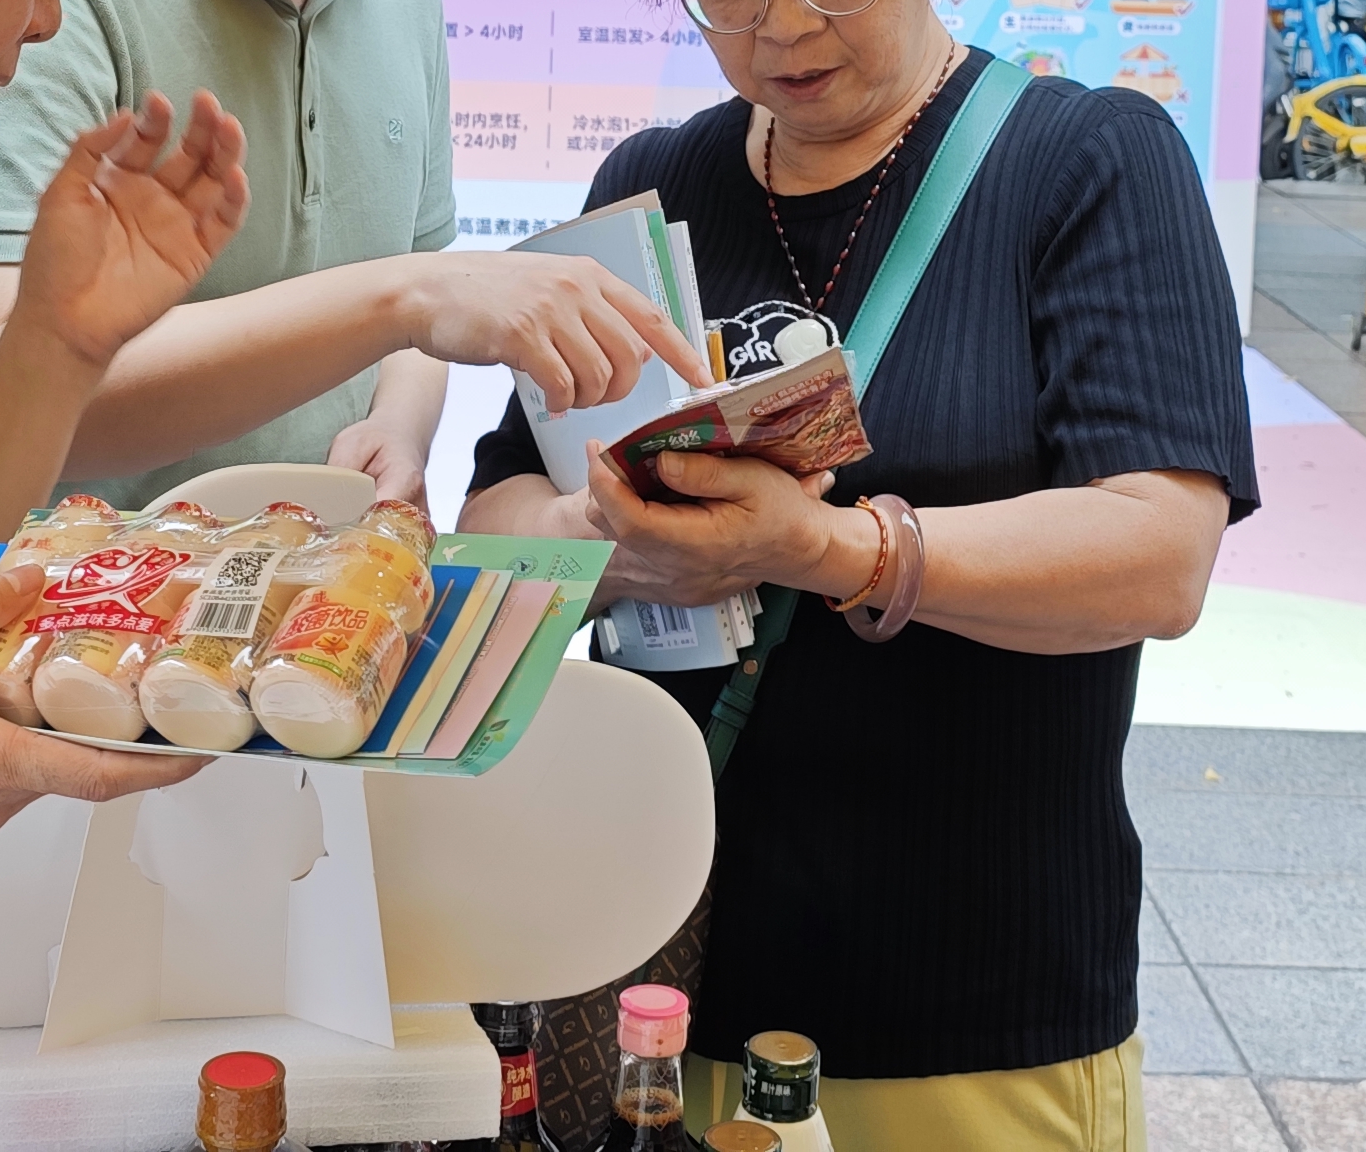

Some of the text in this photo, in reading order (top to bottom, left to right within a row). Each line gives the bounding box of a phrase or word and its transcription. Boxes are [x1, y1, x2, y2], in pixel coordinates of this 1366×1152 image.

[38, 612, 155, 633] 多点滋味多点爱
